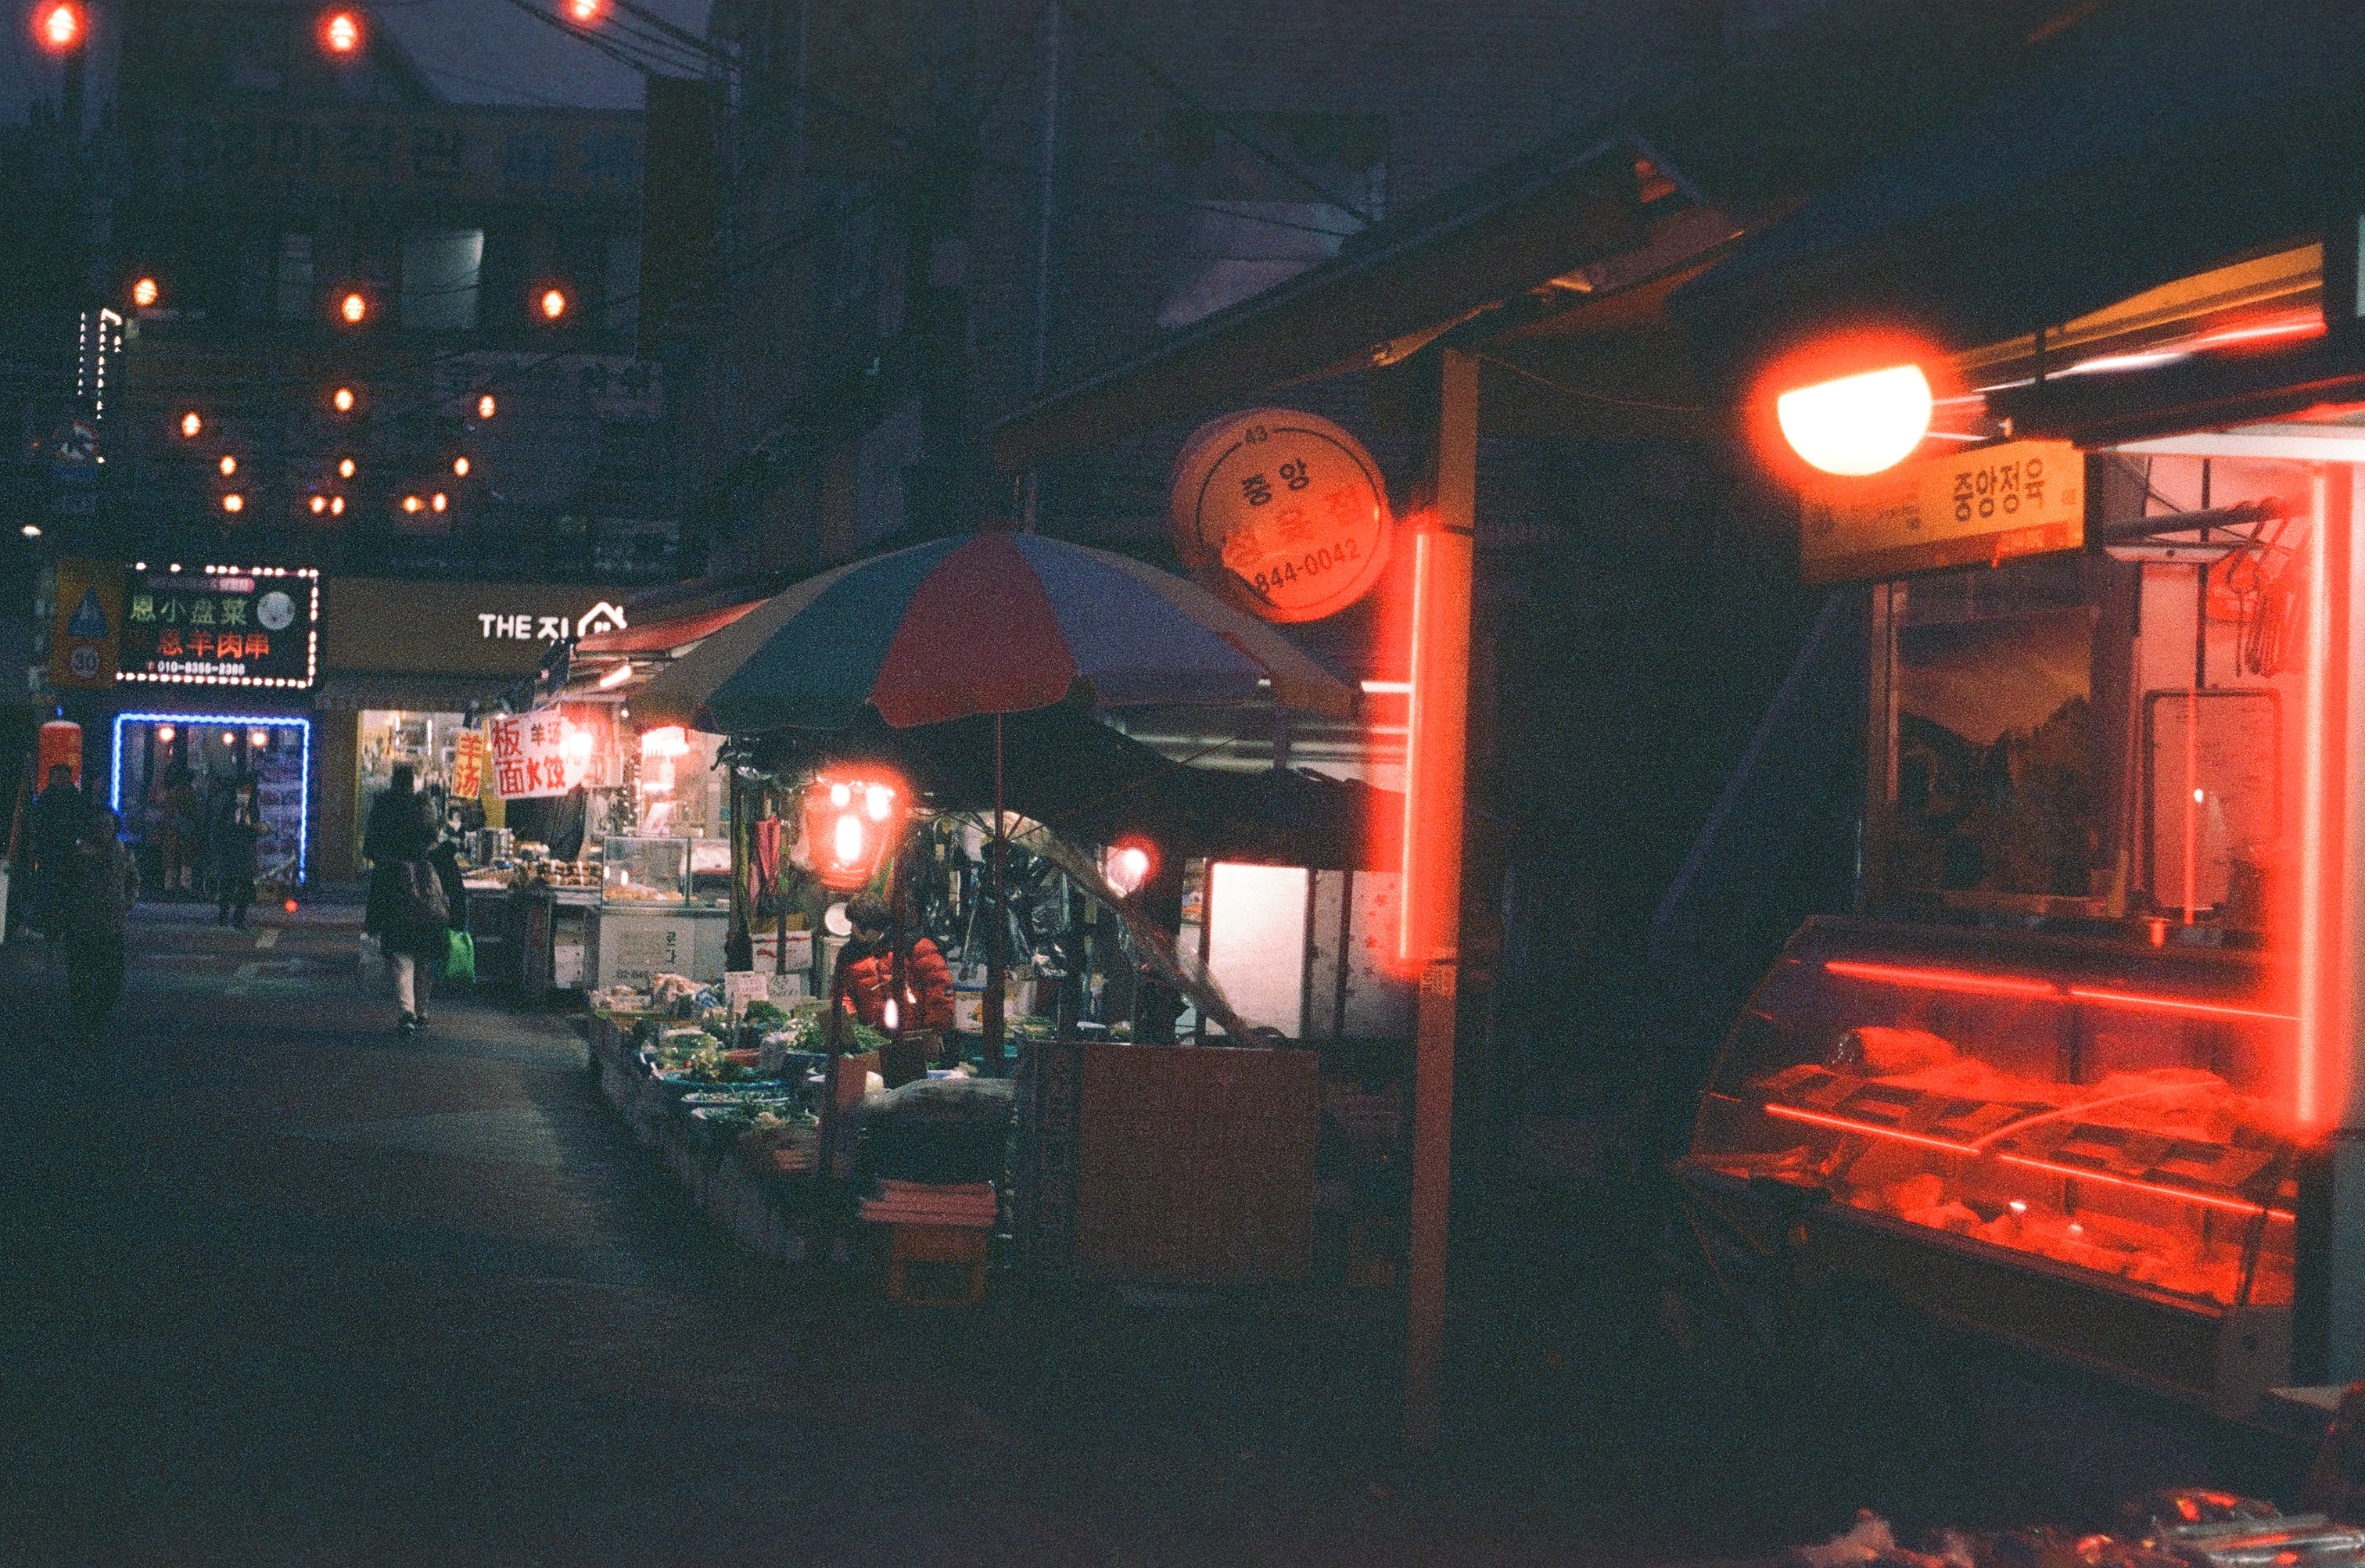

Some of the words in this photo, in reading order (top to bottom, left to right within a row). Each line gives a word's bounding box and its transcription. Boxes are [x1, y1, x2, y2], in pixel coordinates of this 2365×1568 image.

[1244, 425, 1269, 445] 43
[1242, 458, 1311, 507] 중앙
[1953, 457, 2046, 522] 중앙정육
[1254, 538, 1360, 594] 844-0042
[478, 614, 533, 640] THE
